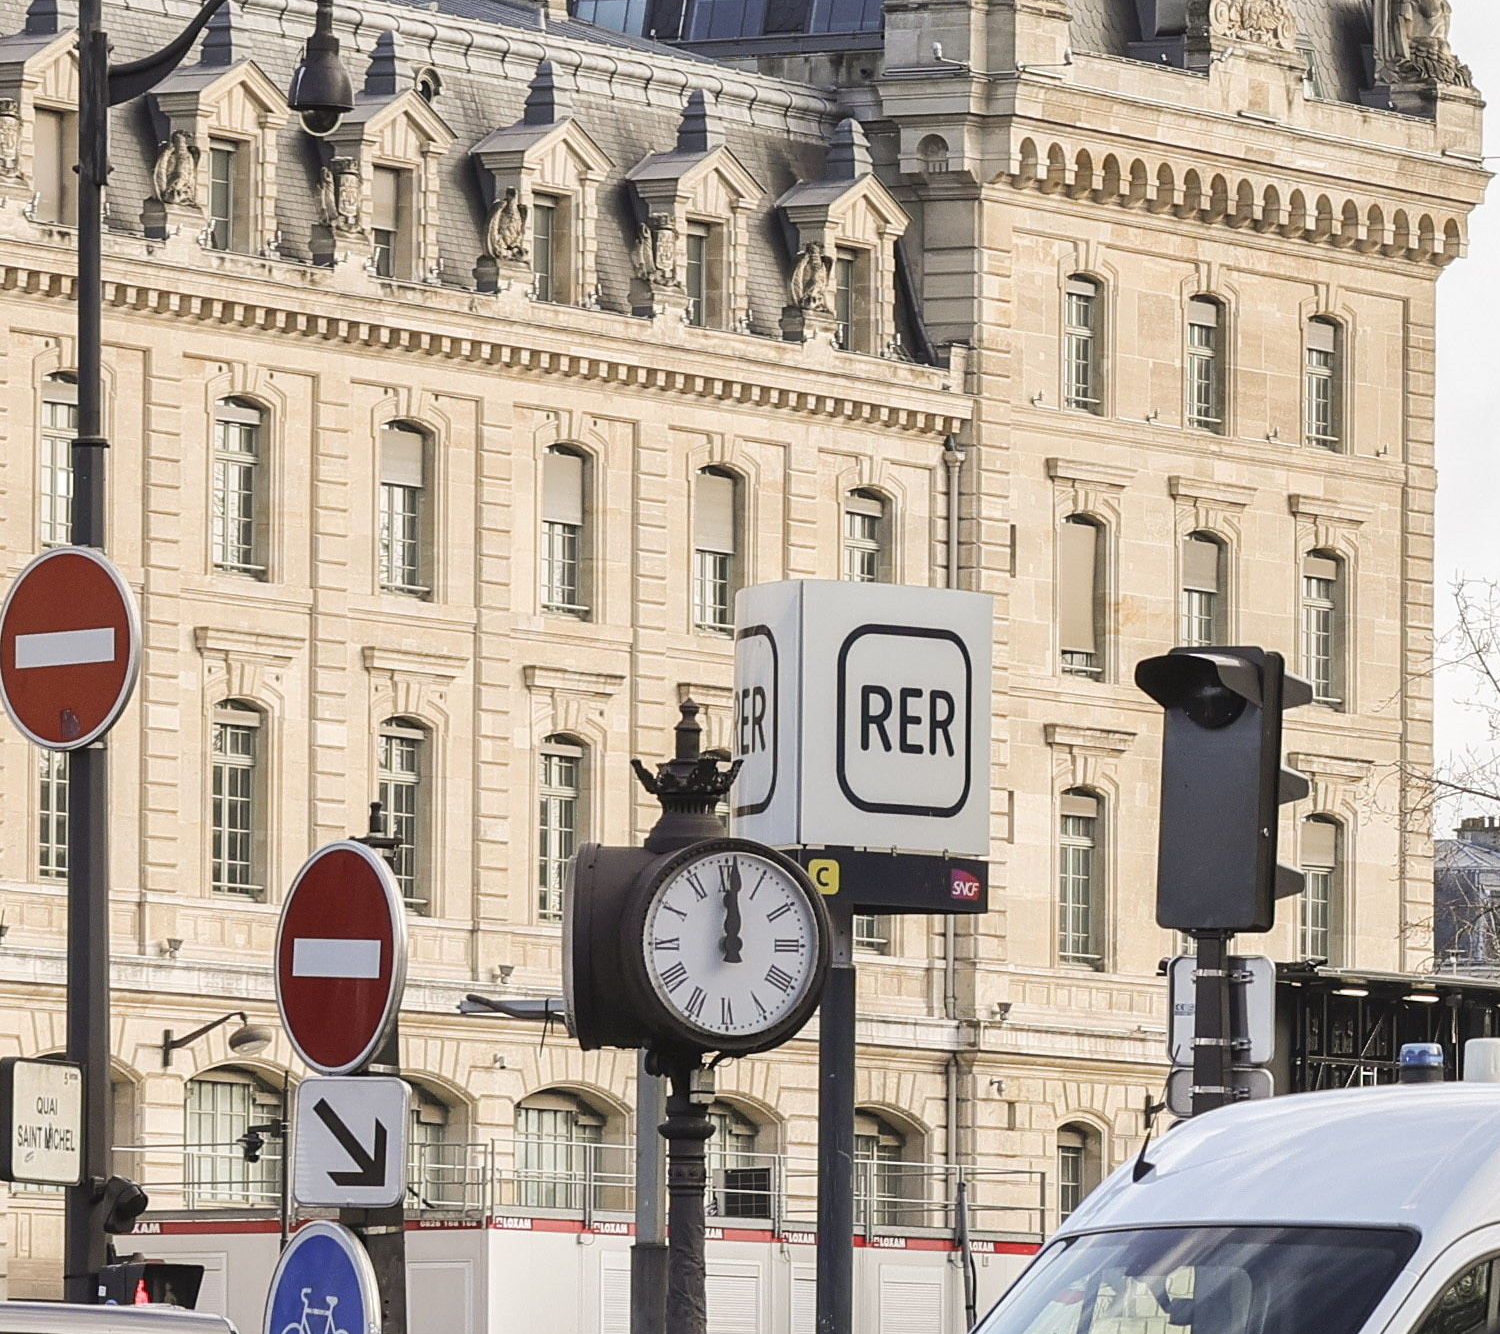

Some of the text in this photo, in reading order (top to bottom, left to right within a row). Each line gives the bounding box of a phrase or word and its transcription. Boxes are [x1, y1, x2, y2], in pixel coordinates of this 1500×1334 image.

[734, 686, 766, 755] RER
[861, 684, 955, 757] RER
[816, 867, 829, 886] C
[952, 880, 980, 897] SNCF
[36, 1096, 58, 1116] QUAI
[17, 1125, 75, 1152] SAINT MICHEL
[131, 1223, 160, 1234] XAM
[503, 1218, 532, 1229] LOXAM
[600, 1222, 628, 1234] LOXAM
[704, 1227, 723, 1239] XAM
[788, 1232, 816, 1244] LOXAM
[880, 1236, 906, 1248] LOXAM
